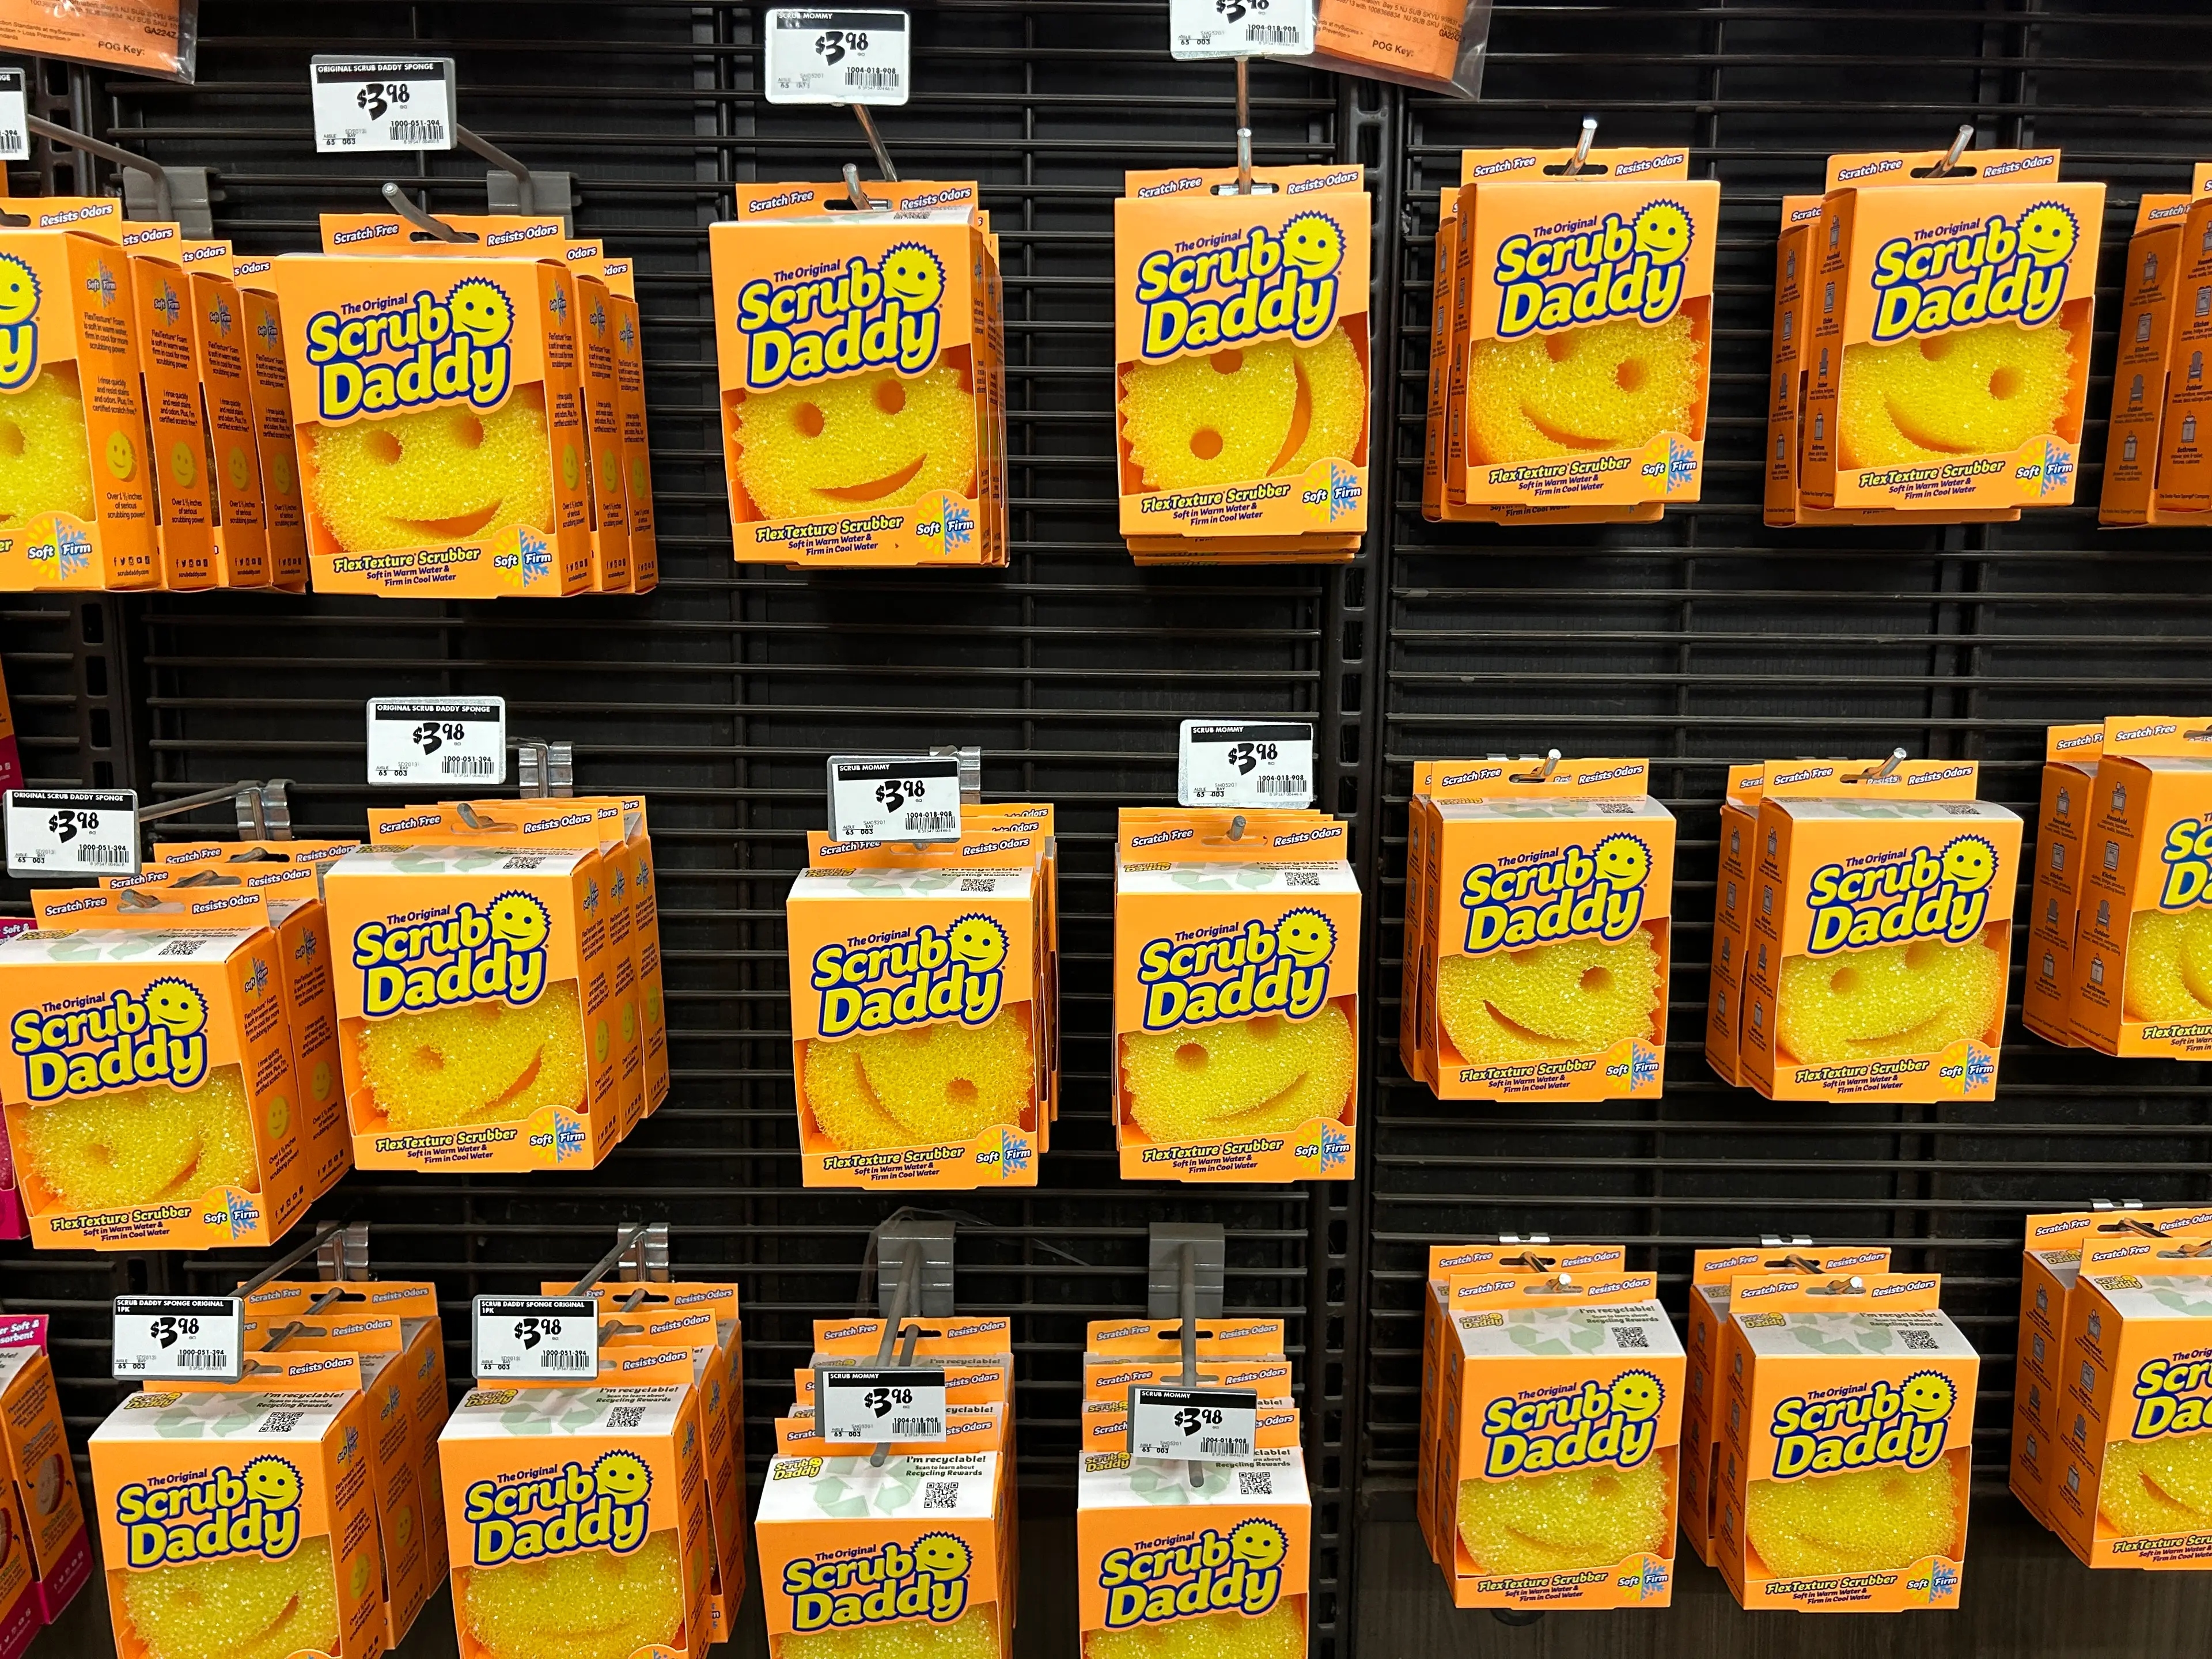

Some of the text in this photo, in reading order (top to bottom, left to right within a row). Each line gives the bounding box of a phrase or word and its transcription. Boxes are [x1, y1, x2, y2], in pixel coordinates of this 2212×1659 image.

[99, 41, 145, 56] POG Key:
[1373, 40, 1414, 56] POG Key:
[1287, 171, 1358, 195] Resists Odors
[1839, 159, 1902, 181] Scratch Free
[1984, 155, 2054, 177] Resists Odors
[334, 224, 399, 245] Scratch Free
[487, 224, 558, 246] Resists Odors
[1175, 229, 1242, 253] The Original
[1494, 213, 1635, 285] Scrub
[1872, 215, 2020, 289] Scrub
[1914, 218, 1980, 241] The Original
[1136, 226, 1282, 303] Scrub
[341, 293, 408, 315] The Original
[737, 256, 885, 334] Scrub
[1142, 266, 1339, 357] Daddy
[1497, 252, 1686, 336] Daddy
[1872, 253, 2067, 341] Daddy
[306, 290, 452, 365] Scrub
[747, 299, 941, 389] Daddy
[320, 333, 510, 419] Daddy
[1570, 457, 1631, 475] Scrubber
[841, 516, 904, 534] Scrubber
[366, 571, 382, 580] Soft
[393, 569, 416, 577] Warm
[414, 575, 431, 584] Cool
[432, 574, 456, 582] Water
[494, 552, 552, 567] Soft Firm
[1442, 768, 1502, 786] Scratch Free
[1578, 765, 1643, 785] Resists Odors
[963, 836, 1029, 857] Resists Odors
[1846, 848, 1907, 867] The Original
[1460, 844, 1597, 910] Scrub
[1806, 846, 1944, 910] Scrub
[353, 903, 493, 969] Scrub
[387, 905, 450, 925] The Original
[1175, 922, 1238, 942] The Original
[1463, 879, 1645, 954] Daddy
[1808, 880, 1989, 955] Daddy
[363, 938, 547, 1017] Daddy
[811, 926, 953, 990] Scrub
[1138, 919, 1278, 984] Scrub
[818, 963, 1006, 1037] Daddy
[1143, 956, 1331, 1031] Daddy
[11, 989, 147, 1055] Scrub
[28, 1025, 209, 1101] Daddy
[530, 1131, 585, 1146] Soft Firm
[1223, 1139, 1283, 1155] Scrubber
[1741, 1281, 1798, 1299] Scratch Free
[1872, 1279, 1934, 1298] Resists Odors
[1097, 1325, 1150, 1341] Scratch Free
[1219, 1324, 1278, 1340] Resists Odors
[1481, 1380, 1612, 1437] Scrub
[1771, 1380, 1901, 1438] Scrub
[1808, 1383, 1867, 1400] The Original
[925, 1455, 986, 1464] recyclable!
[1485, 1412, 1657, 1478] Daddy
[1773, 1412, 1947, 1478] Daddy
[116, 1467, 245, 1525] Scrub
[147, 1468, 207, 1486] The Original
[465, 1462, 596, 1522] Scrub
[906, 1469, 945, 1478] Recycling
[128, 1499, 300, 1568] Daddy
[474, 1495, 649, 1566] Daddy
[815, 1544, 877, 1561] The Original
[783, 1542, 916, 1594] Scrub
[1099, 1529, 1232, 1589] Scrub
[1552, 1572, 1608, 1585] Scrubber
[794, 1570, 968, 1633] Daddy
[1106, 1559, 1281, 1628] Daddy
